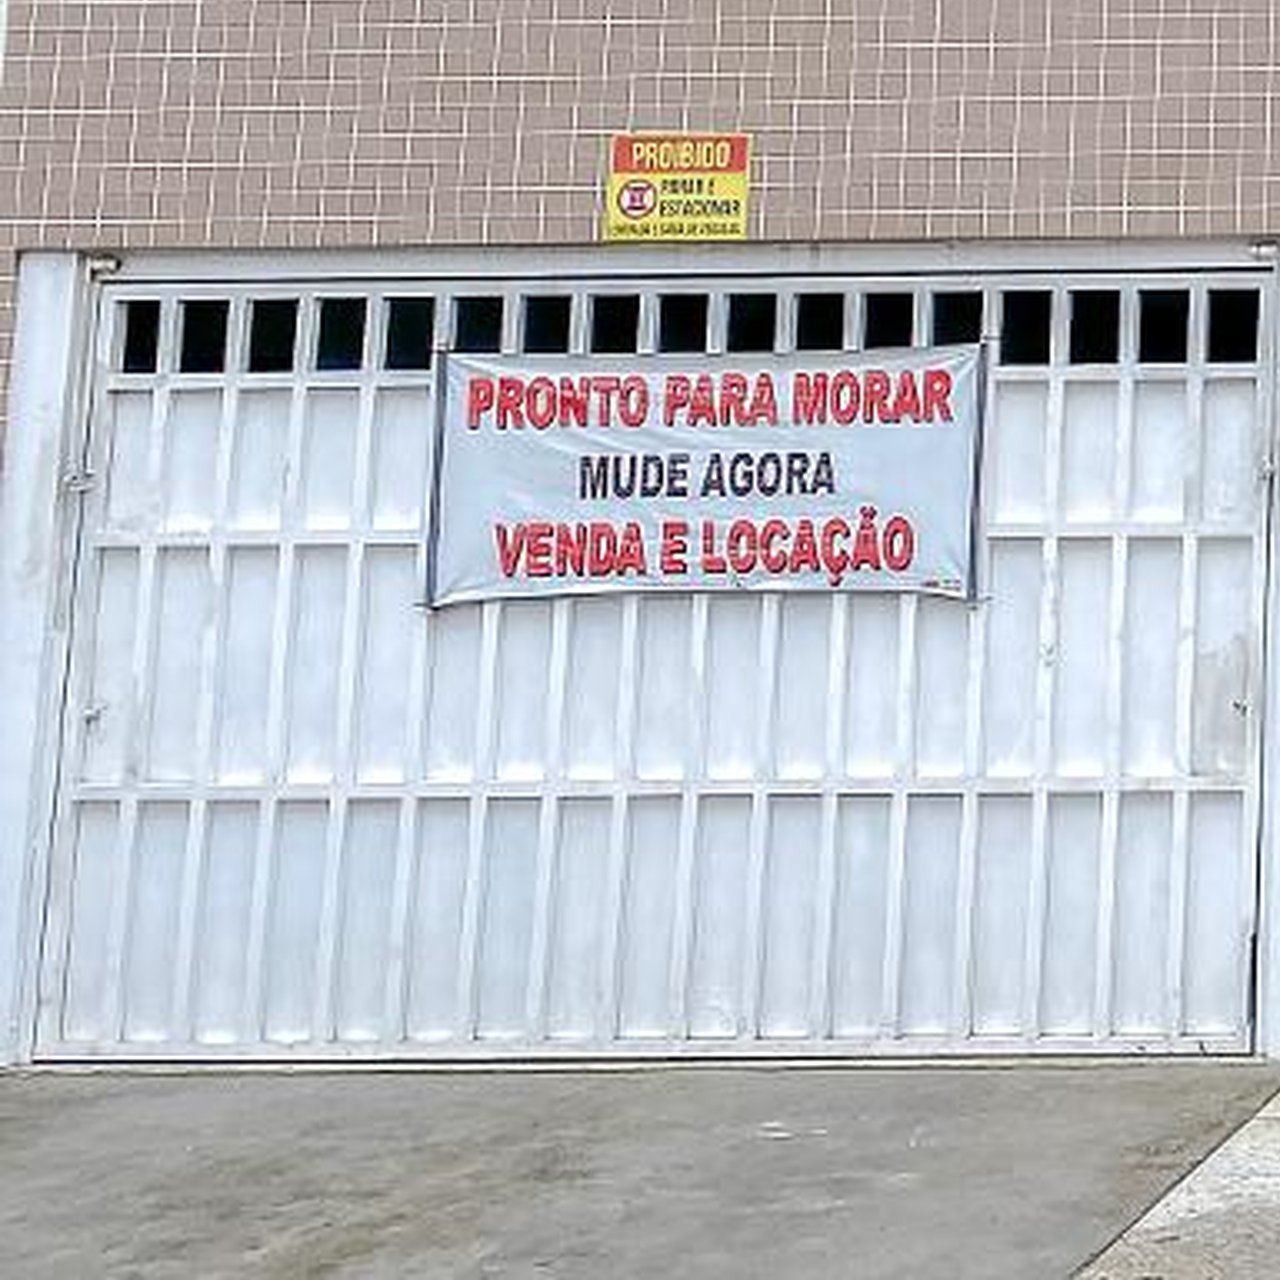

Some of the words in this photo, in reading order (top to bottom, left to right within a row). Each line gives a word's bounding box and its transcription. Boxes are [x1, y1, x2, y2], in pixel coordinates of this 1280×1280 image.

[632, 141, 731, 169] PROIBIDO
[467, 375, 649, 431] PRONTO
[662, 373, 778, 427] PARA
[792, 369, 954, 426] MORAR
[579, 454, 691, 499] MUDE
[700, 451, 836, 497] AGORA
[494, 522, 647, 578] VENDA
[659, 521, 690, 575] E
[700, 505, 916, 587] LOCAÇÃO
